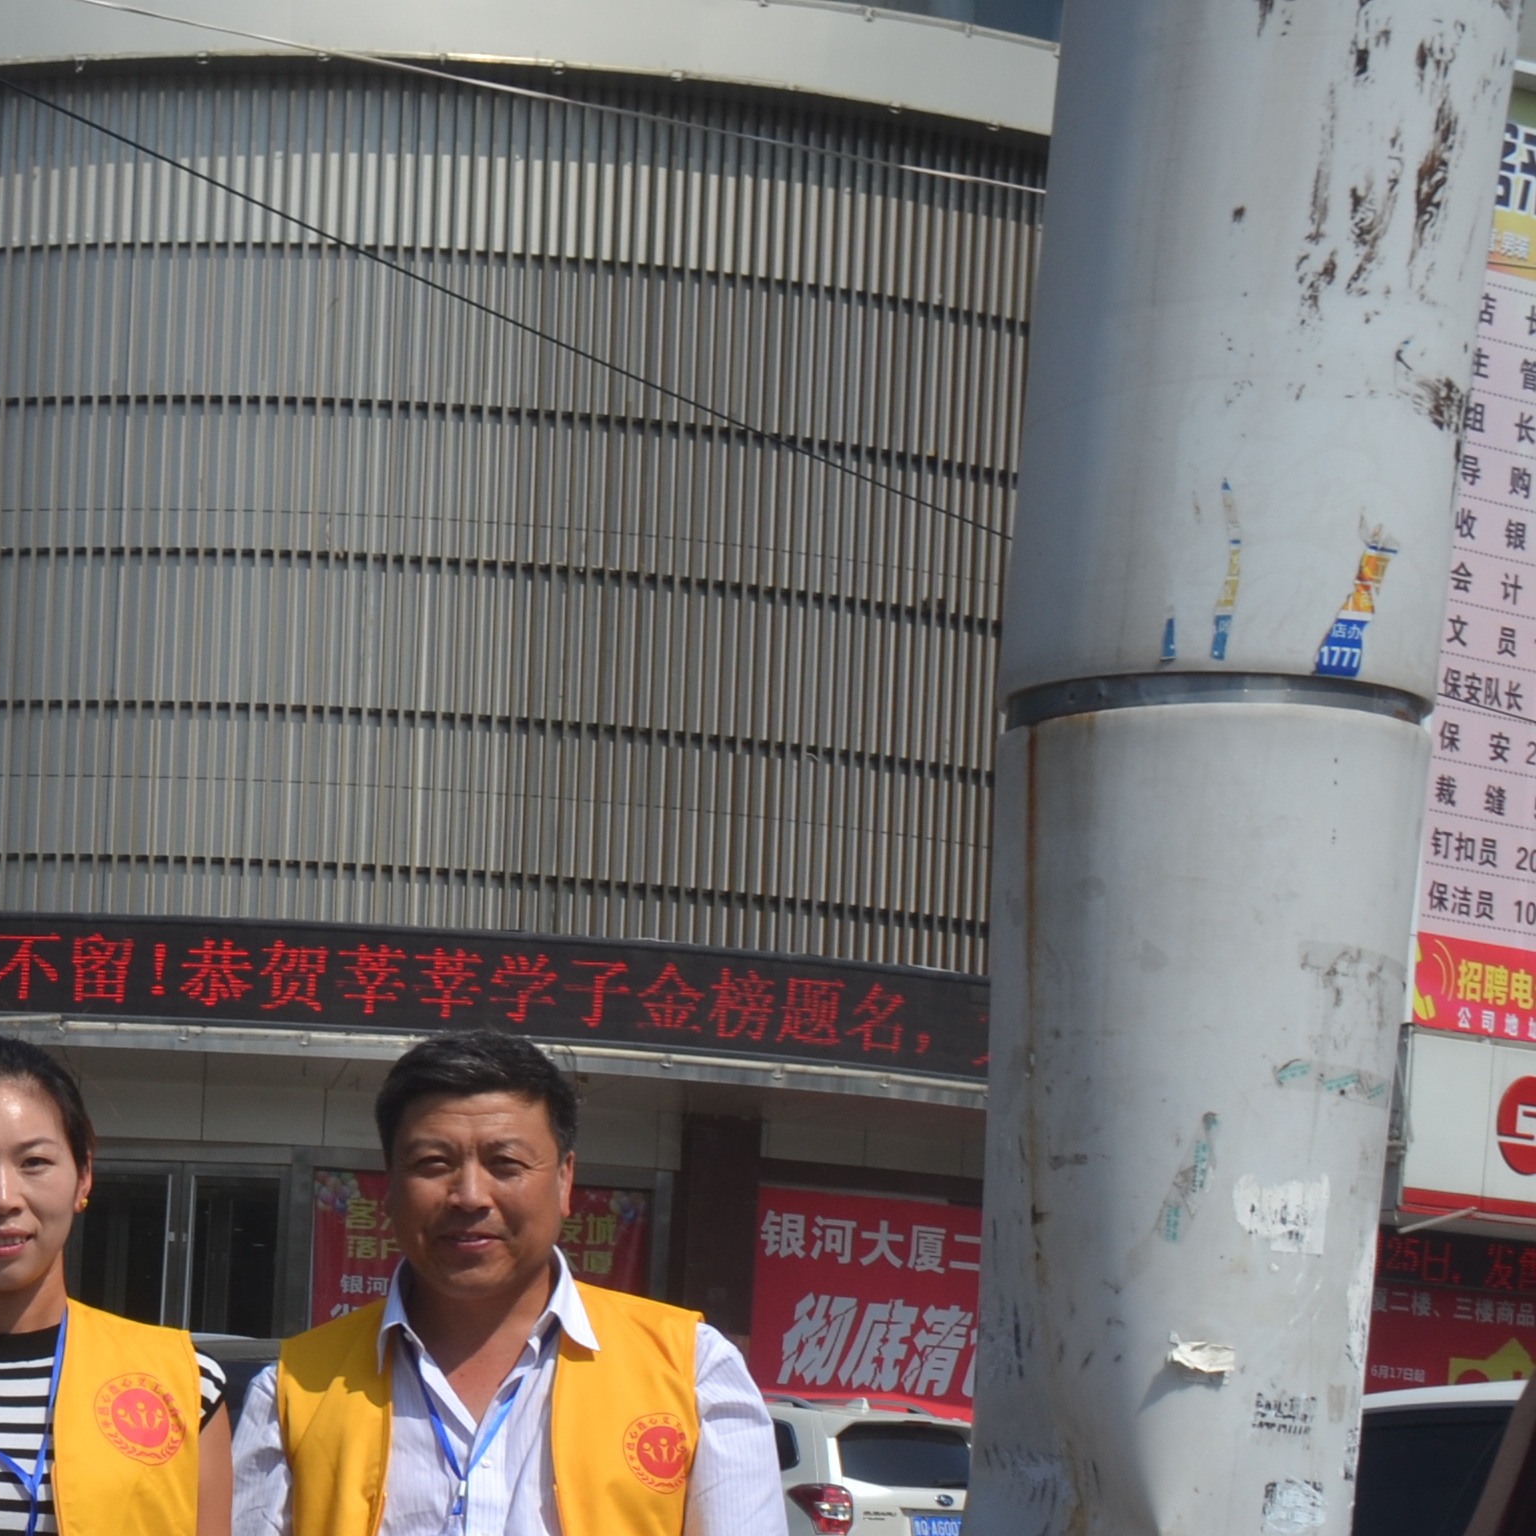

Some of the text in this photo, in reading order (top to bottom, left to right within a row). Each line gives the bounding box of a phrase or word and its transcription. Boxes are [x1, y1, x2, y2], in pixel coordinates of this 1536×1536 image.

[1460, 454, 1532, 501] 导购
[1455, 507, 1527, 552] 收银
[1450, 561, 1524, 607] 会计
[1446, 614, 1518, 659] 文员
[1442, 666, 1523, 712] 保安队长
[1439, 719, 1511, 764] 保安
[1434, 773, 1507, 817] 裁缝
[1430, 826, 1498, 869] 钉扣员
[1427, 880, 1495, 922] 保洁员
[776, 1291, 978, 1398] 彻底清
